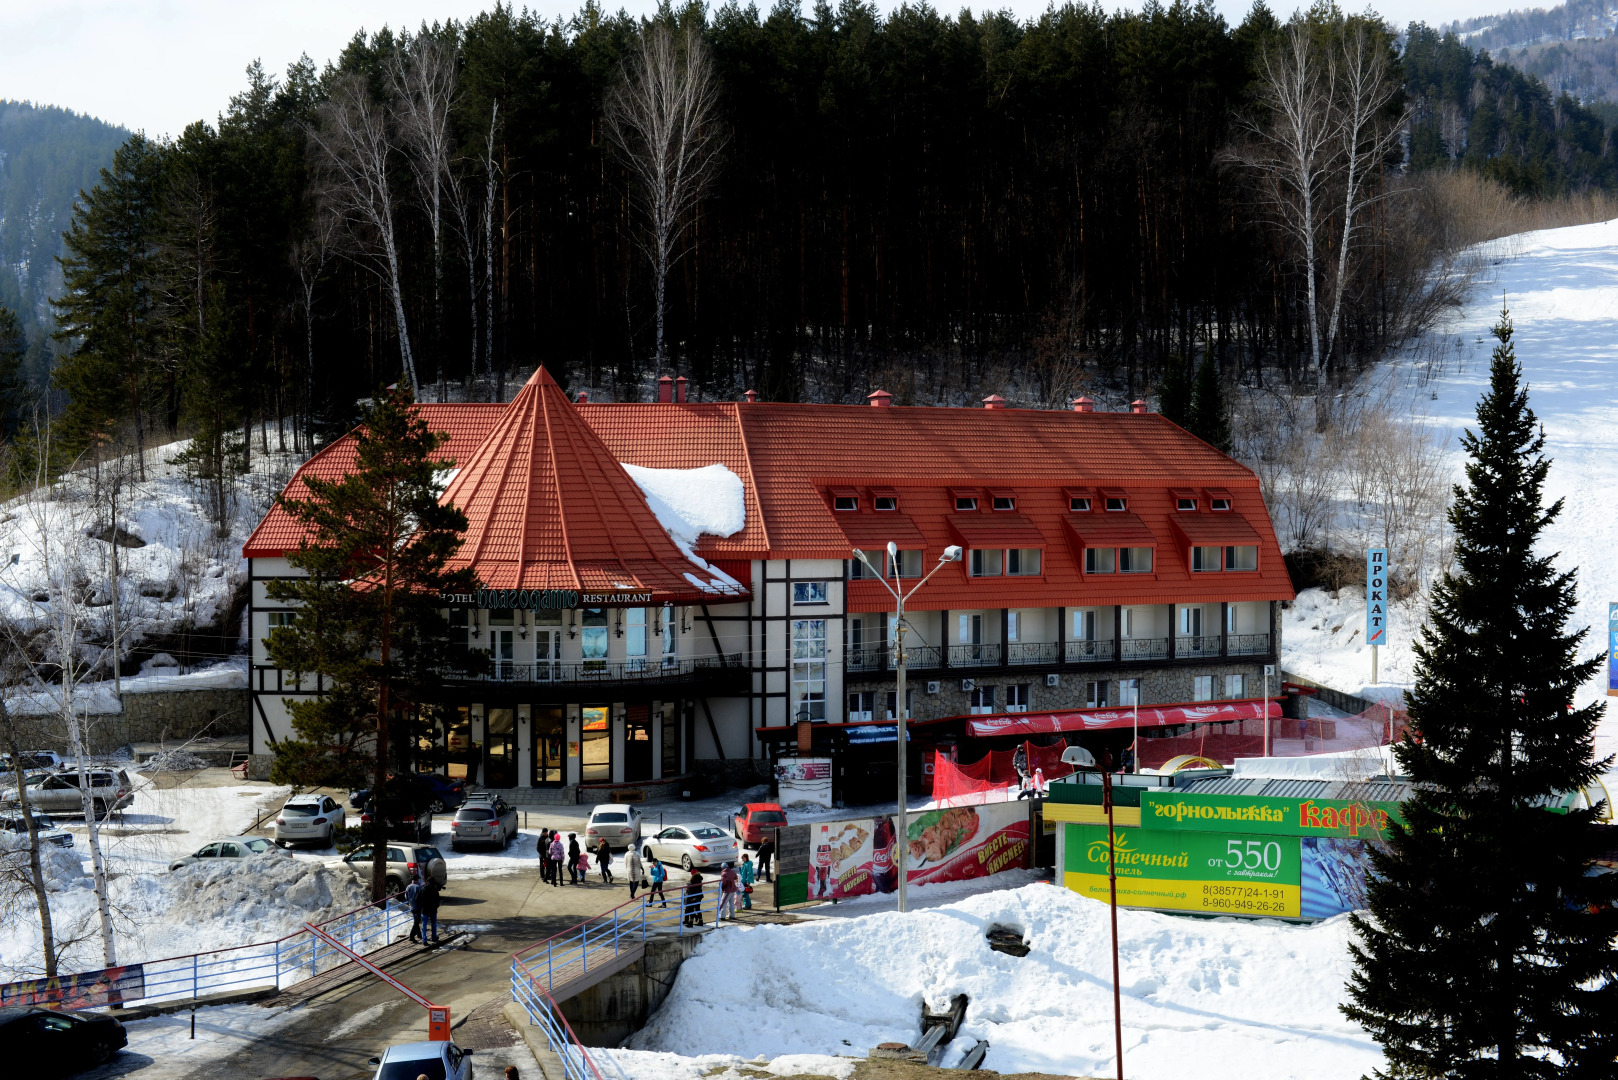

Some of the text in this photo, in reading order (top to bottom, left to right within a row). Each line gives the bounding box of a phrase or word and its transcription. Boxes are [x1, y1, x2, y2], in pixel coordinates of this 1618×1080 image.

[438, 593, 476, 604] HOTEL
[582, 592, 652, 603] RESTAURANT
[1371, 552, 1383, 627] ПРОКАТ
[1299, 800, 1388, 836] кафе
[977, 832, 1008, 865] ВМЕСТЕ
[1087, 846, 1189, 867] Солнечный
[1208, 840, 1282, 871] от 550
[1202, 885, 1284, 899] 8(38577)24-1-91
[1202, 897, 1285, 912] 8-960-949-26-26
